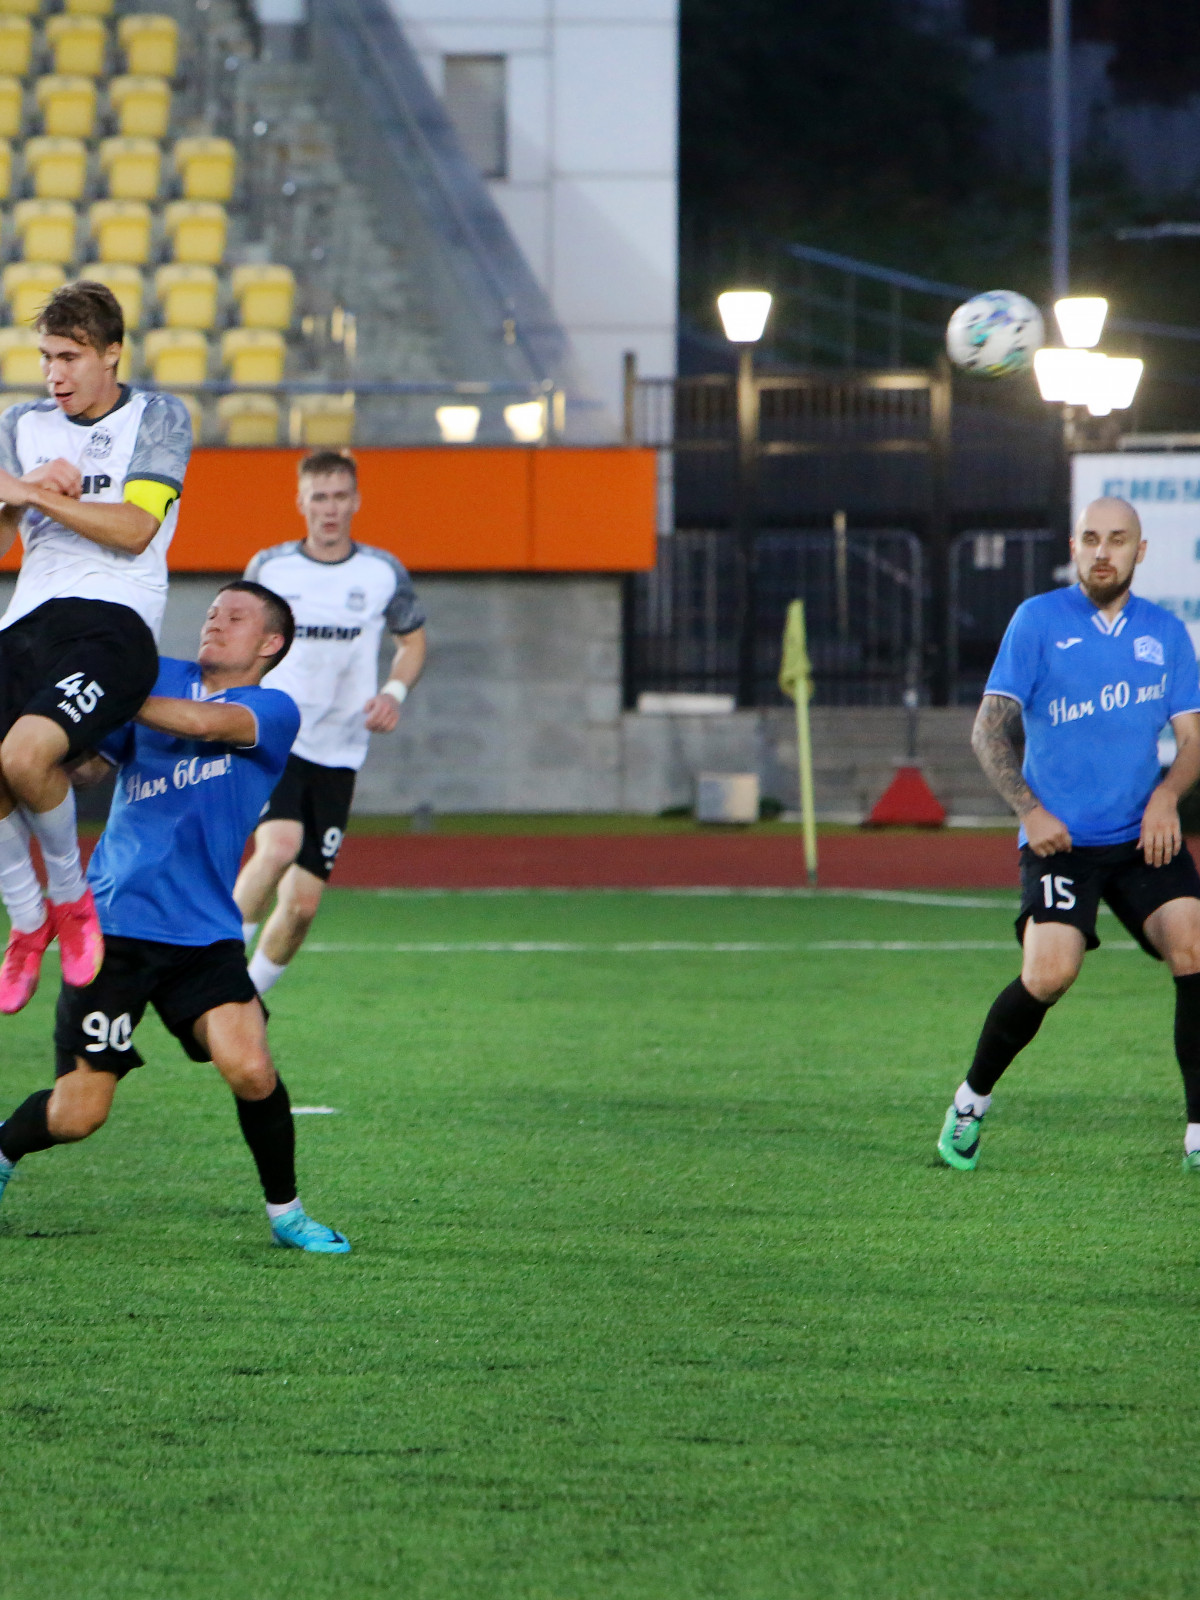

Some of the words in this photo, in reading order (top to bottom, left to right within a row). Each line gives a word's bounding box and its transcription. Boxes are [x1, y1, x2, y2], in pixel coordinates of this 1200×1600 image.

[54, 671, 105, 714] 45
[56, 700, 82, 723] JAKO
[1100, 680, 1130, 711] 60
[1040, 873, 1076, 911] 15
[82, 1010, 132, 1052] 90
